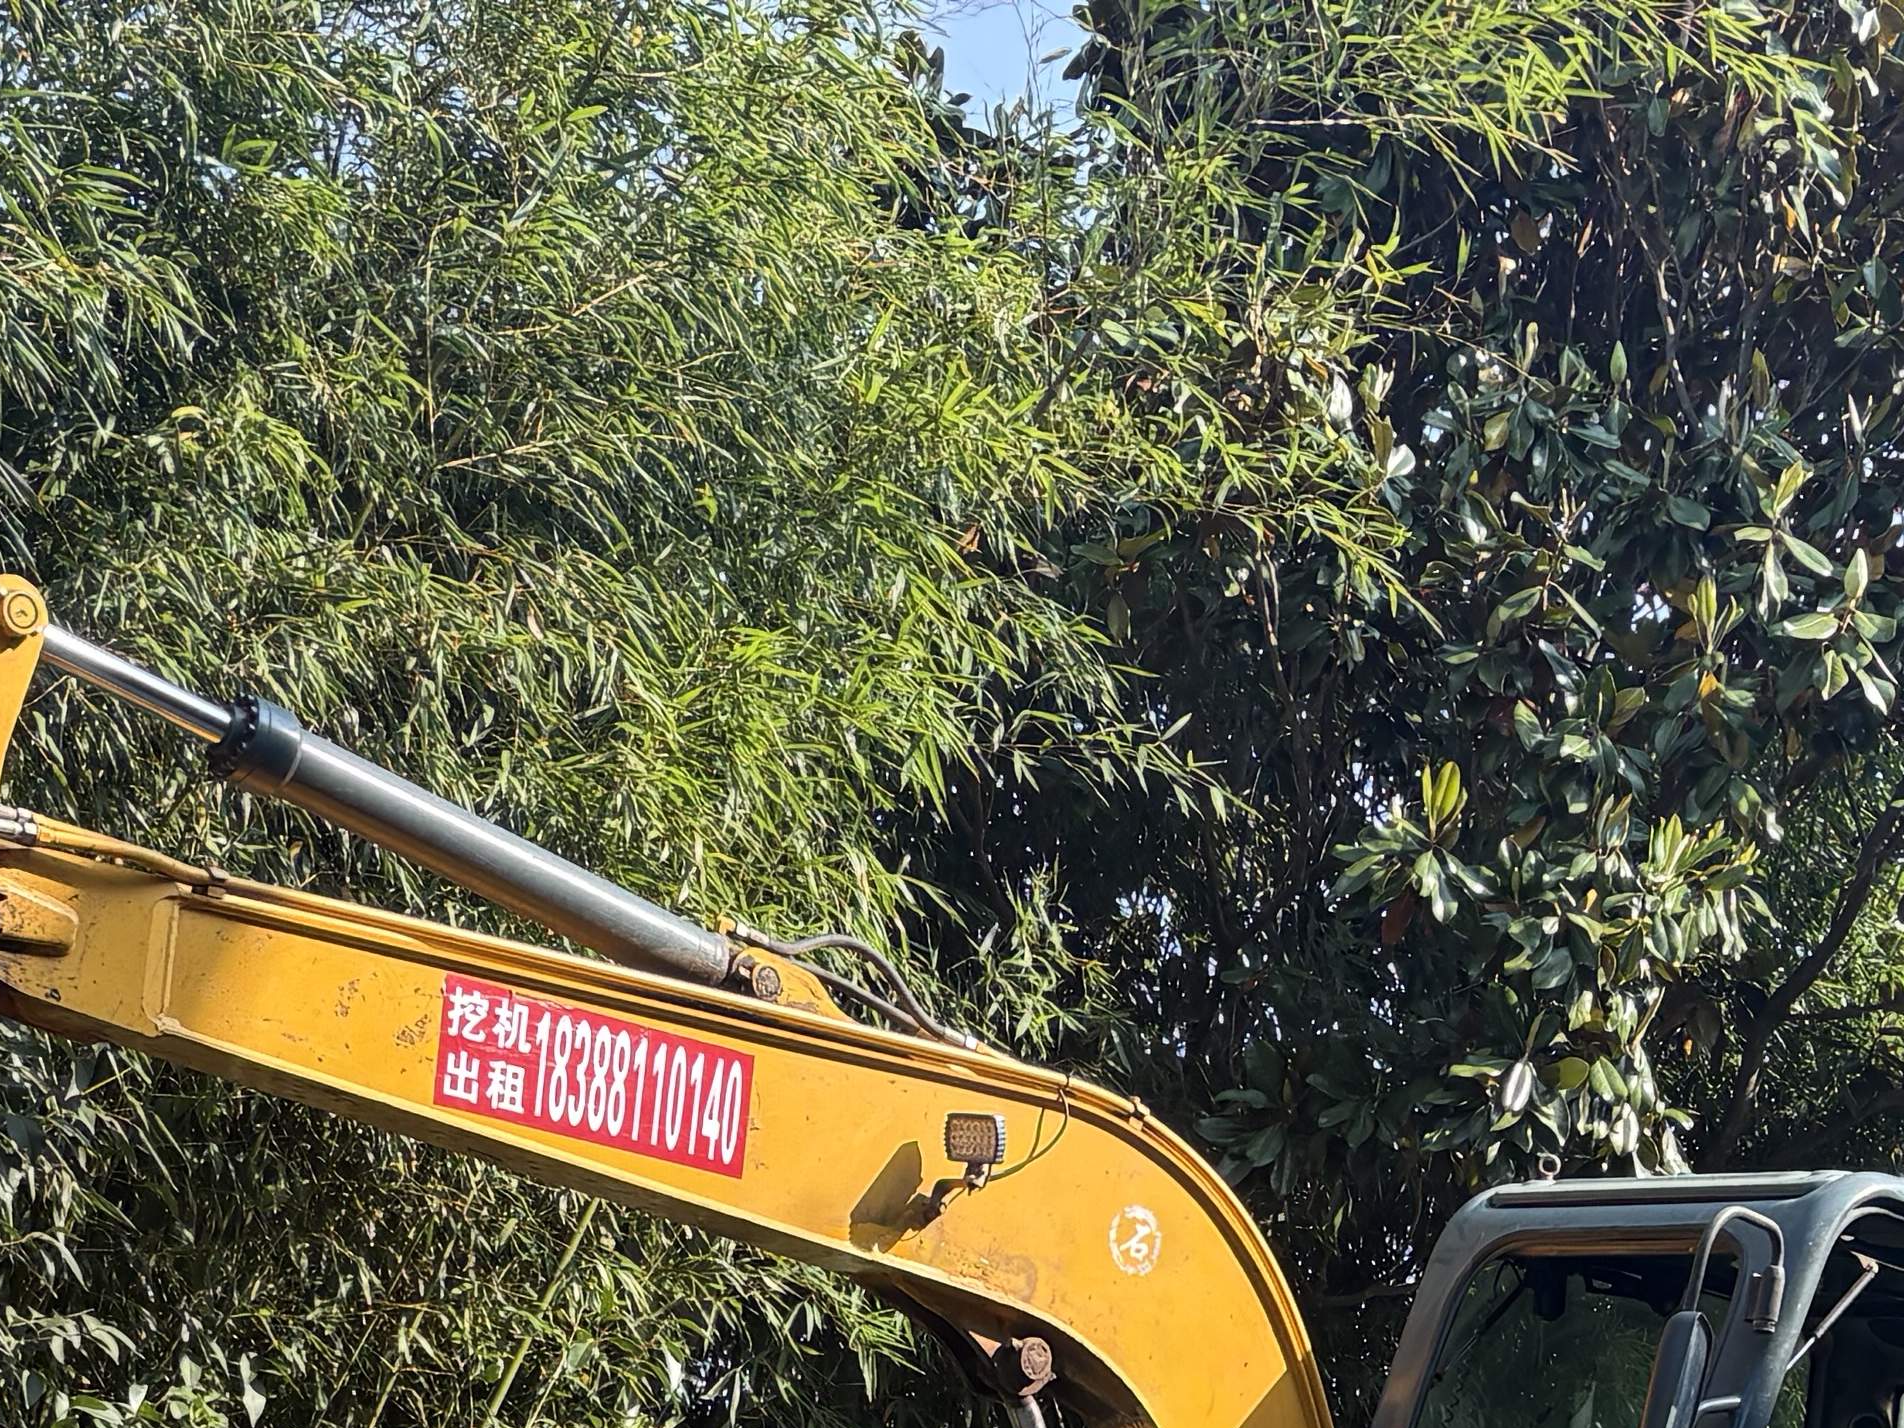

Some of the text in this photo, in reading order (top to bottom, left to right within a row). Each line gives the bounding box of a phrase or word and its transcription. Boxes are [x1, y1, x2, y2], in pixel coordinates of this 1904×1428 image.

[447, 987, 532, 1054] 挖机
[443, 1051, 525, 1114] 出租
[534, 1012, 743, 1165] 18388110140
